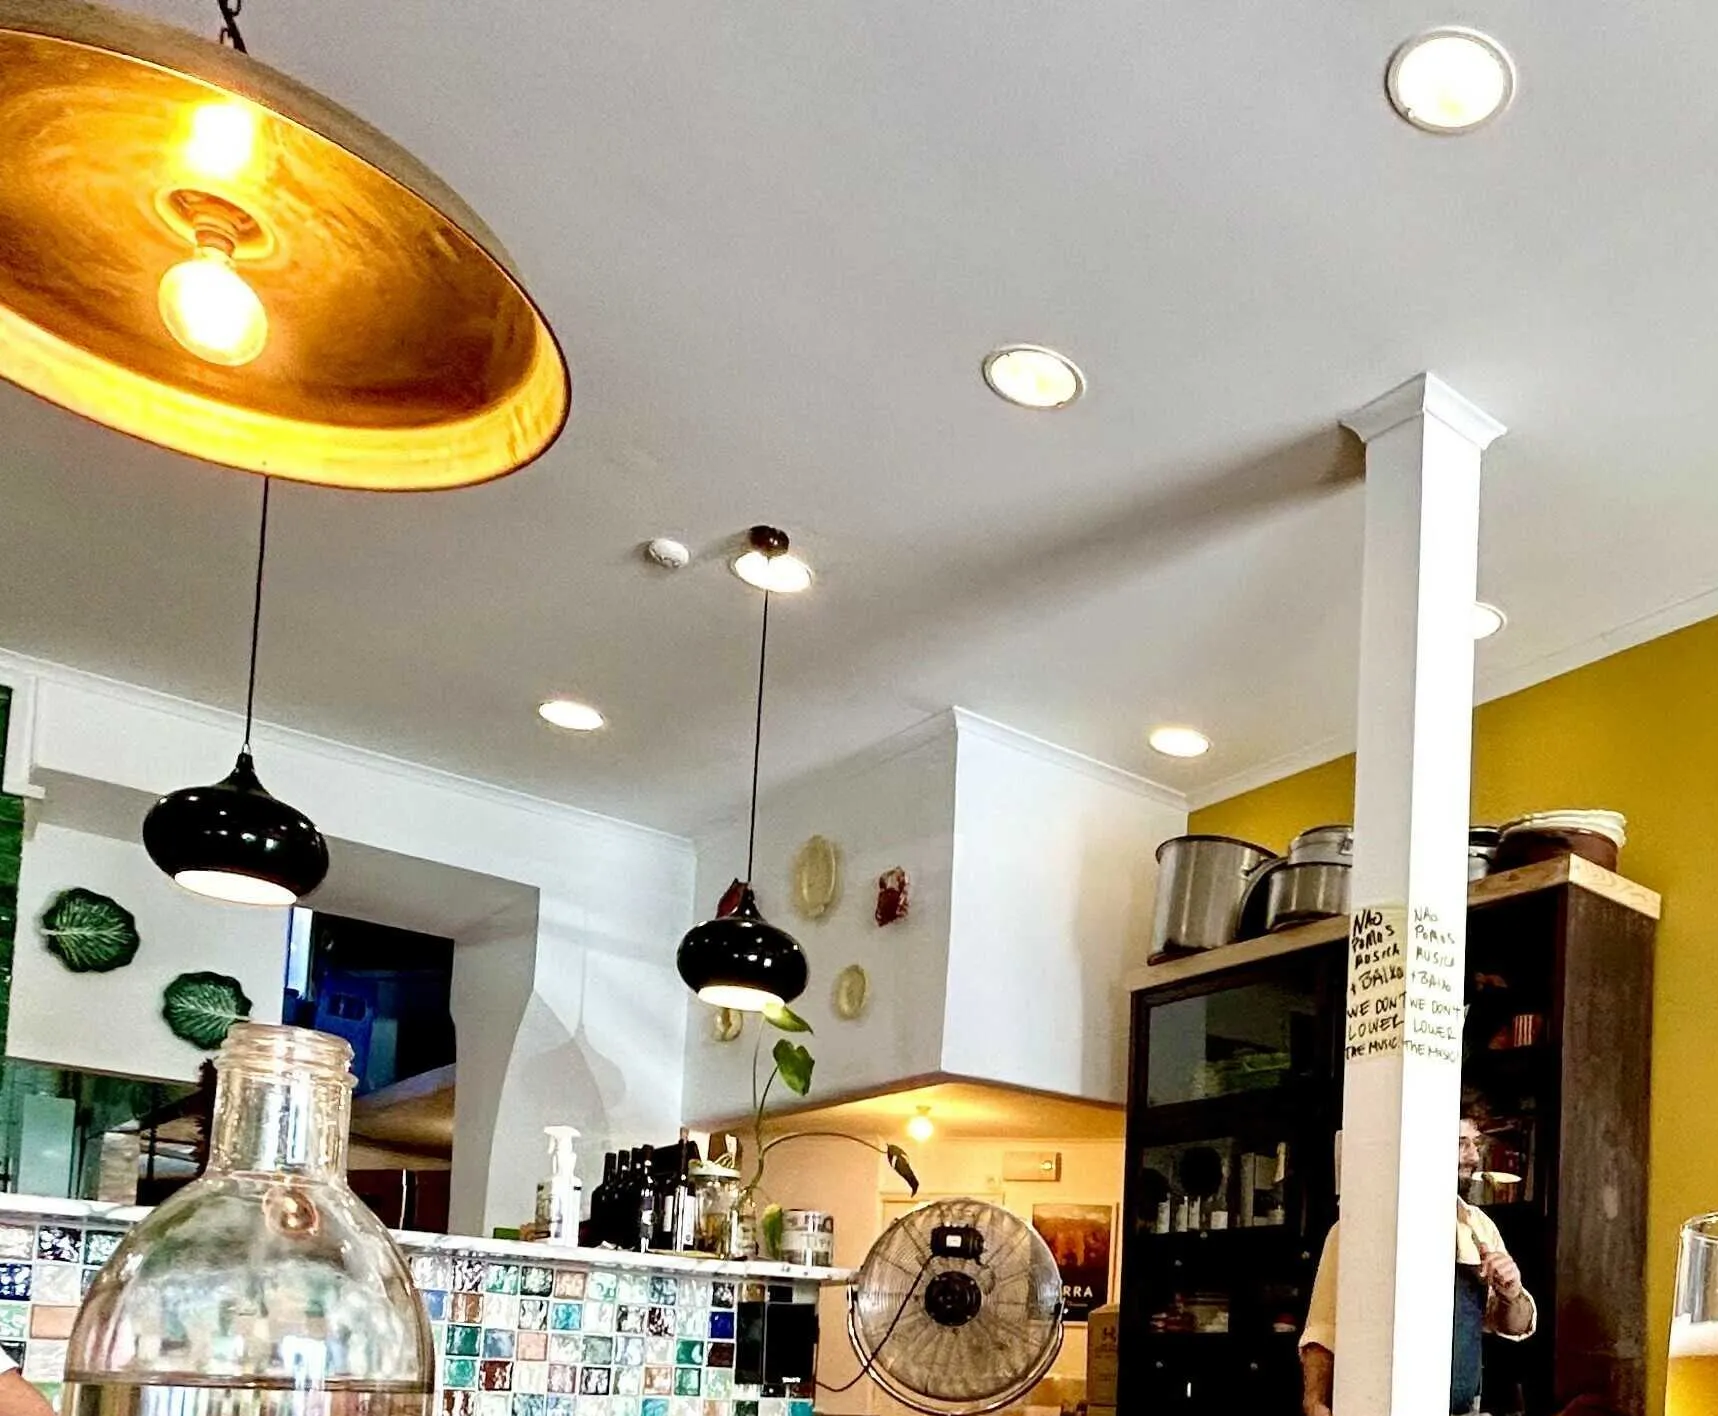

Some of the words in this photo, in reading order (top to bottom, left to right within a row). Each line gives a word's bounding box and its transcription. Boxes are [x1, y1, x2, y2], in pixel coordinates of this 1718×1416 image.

[1358, 966, 1404, 990] BAIXO
[1347, 1000, 1370, 1018] WE
[1409, 997, 1425, 1011] WE
[1348, 1014, 1404, 1041] LOWER
[1414, 1016, 1457, 1040] LOWER
[1345, 1044, 1365, 1060] THE
[1403, 1040, 1425, 1056] THE
[1063, 1285, 1094, 1298] RRA
